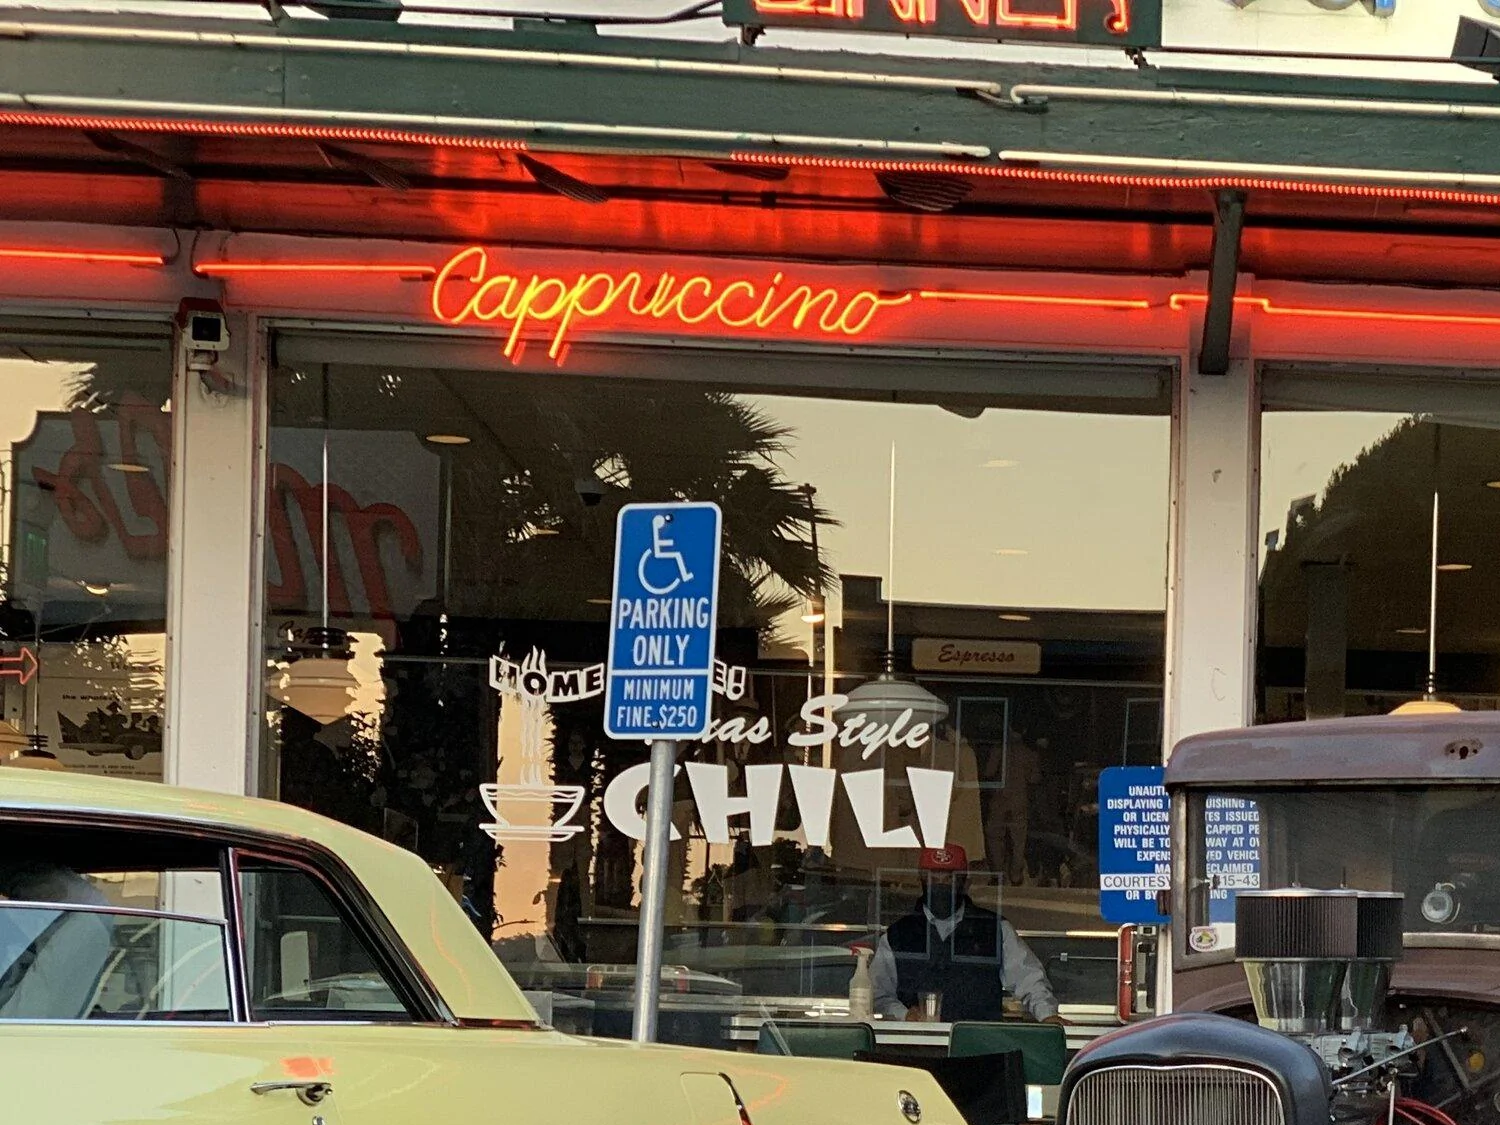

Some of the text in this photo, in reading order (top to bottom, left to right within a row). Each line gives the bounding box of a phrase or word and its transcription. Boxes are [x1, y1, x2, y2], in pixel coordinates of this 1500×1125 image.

[432, 246, 911, 358] Cappuccino
[617, 597, 710, 630] PARKING
[632, 634, 690, 667] ONLY
[937, 644, 1015, 666] Espresso
[488, 653, 605, 704] HOME
[623, 678, 695, 701] MINIMUM
[787, 693, 930, 760] Style
[603, 760, 955, 849] CHILI
[1107, 799, 1163, 810] DISPLAYING
[1123, 812, 1137, 822] OR
[1225, 811, 1260, 822] ISSUED
[1114, 825, 1171, 835] PHYSICALLY
[1113, 838, 1137, 848] WILL
[1142, 838, 1155, 848] BE
[1232, 838, 1245, 848] AT
[1125, 890, 1140, 900] OR
[1144, 890, 1159, 900] BY
